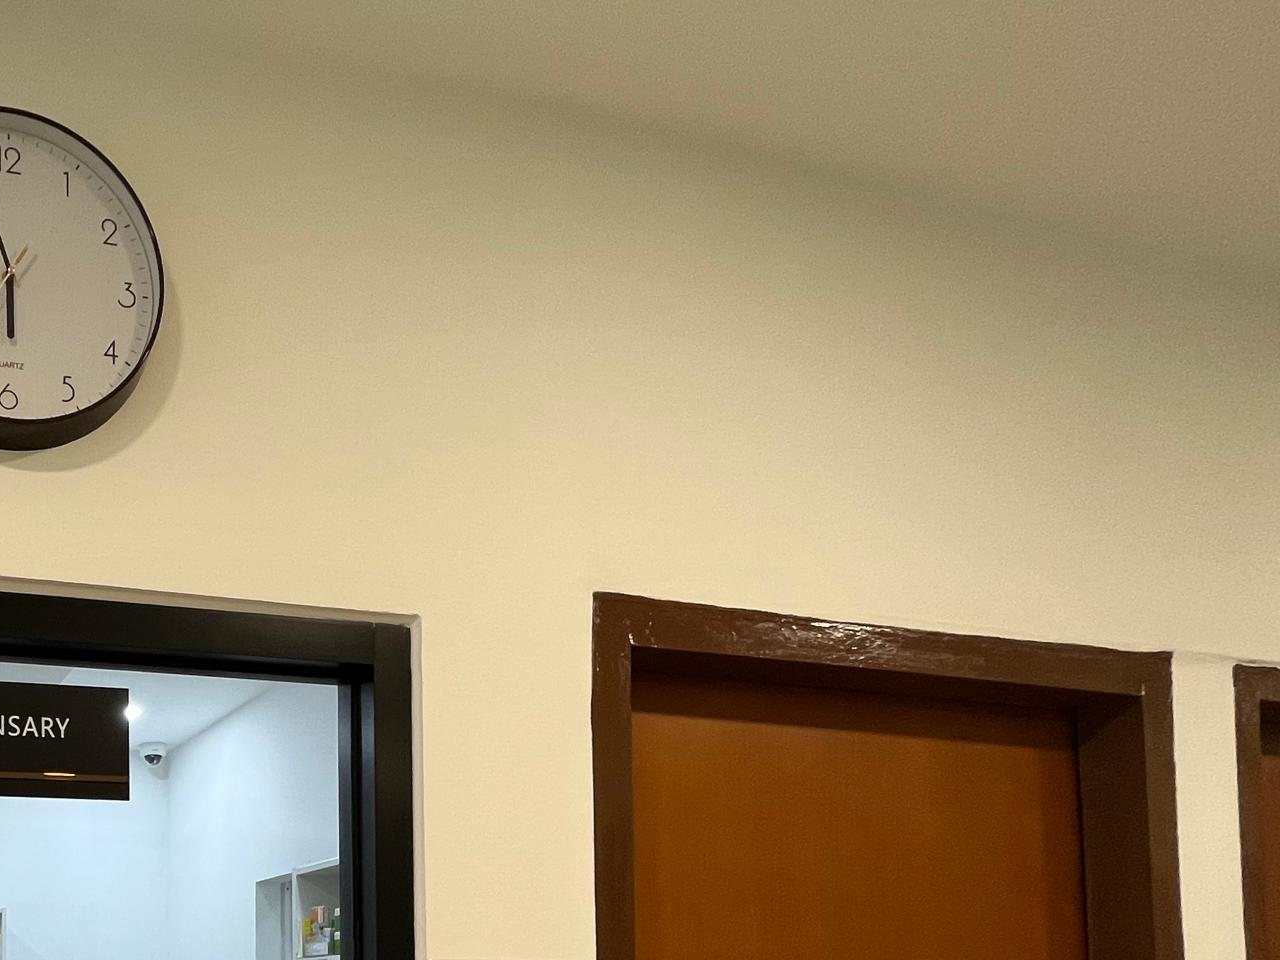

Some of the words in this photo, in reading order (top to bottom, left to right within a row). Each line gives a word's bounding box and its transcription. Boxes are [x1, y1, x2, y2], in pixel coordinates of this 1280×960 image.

[63, 171, 70, 197] 1
[101, 218, 118, 246] 2
[118, 282, 137, 308] 3
[104, 340, 119, 365] 4
[61, 375, 76, 402] 5
